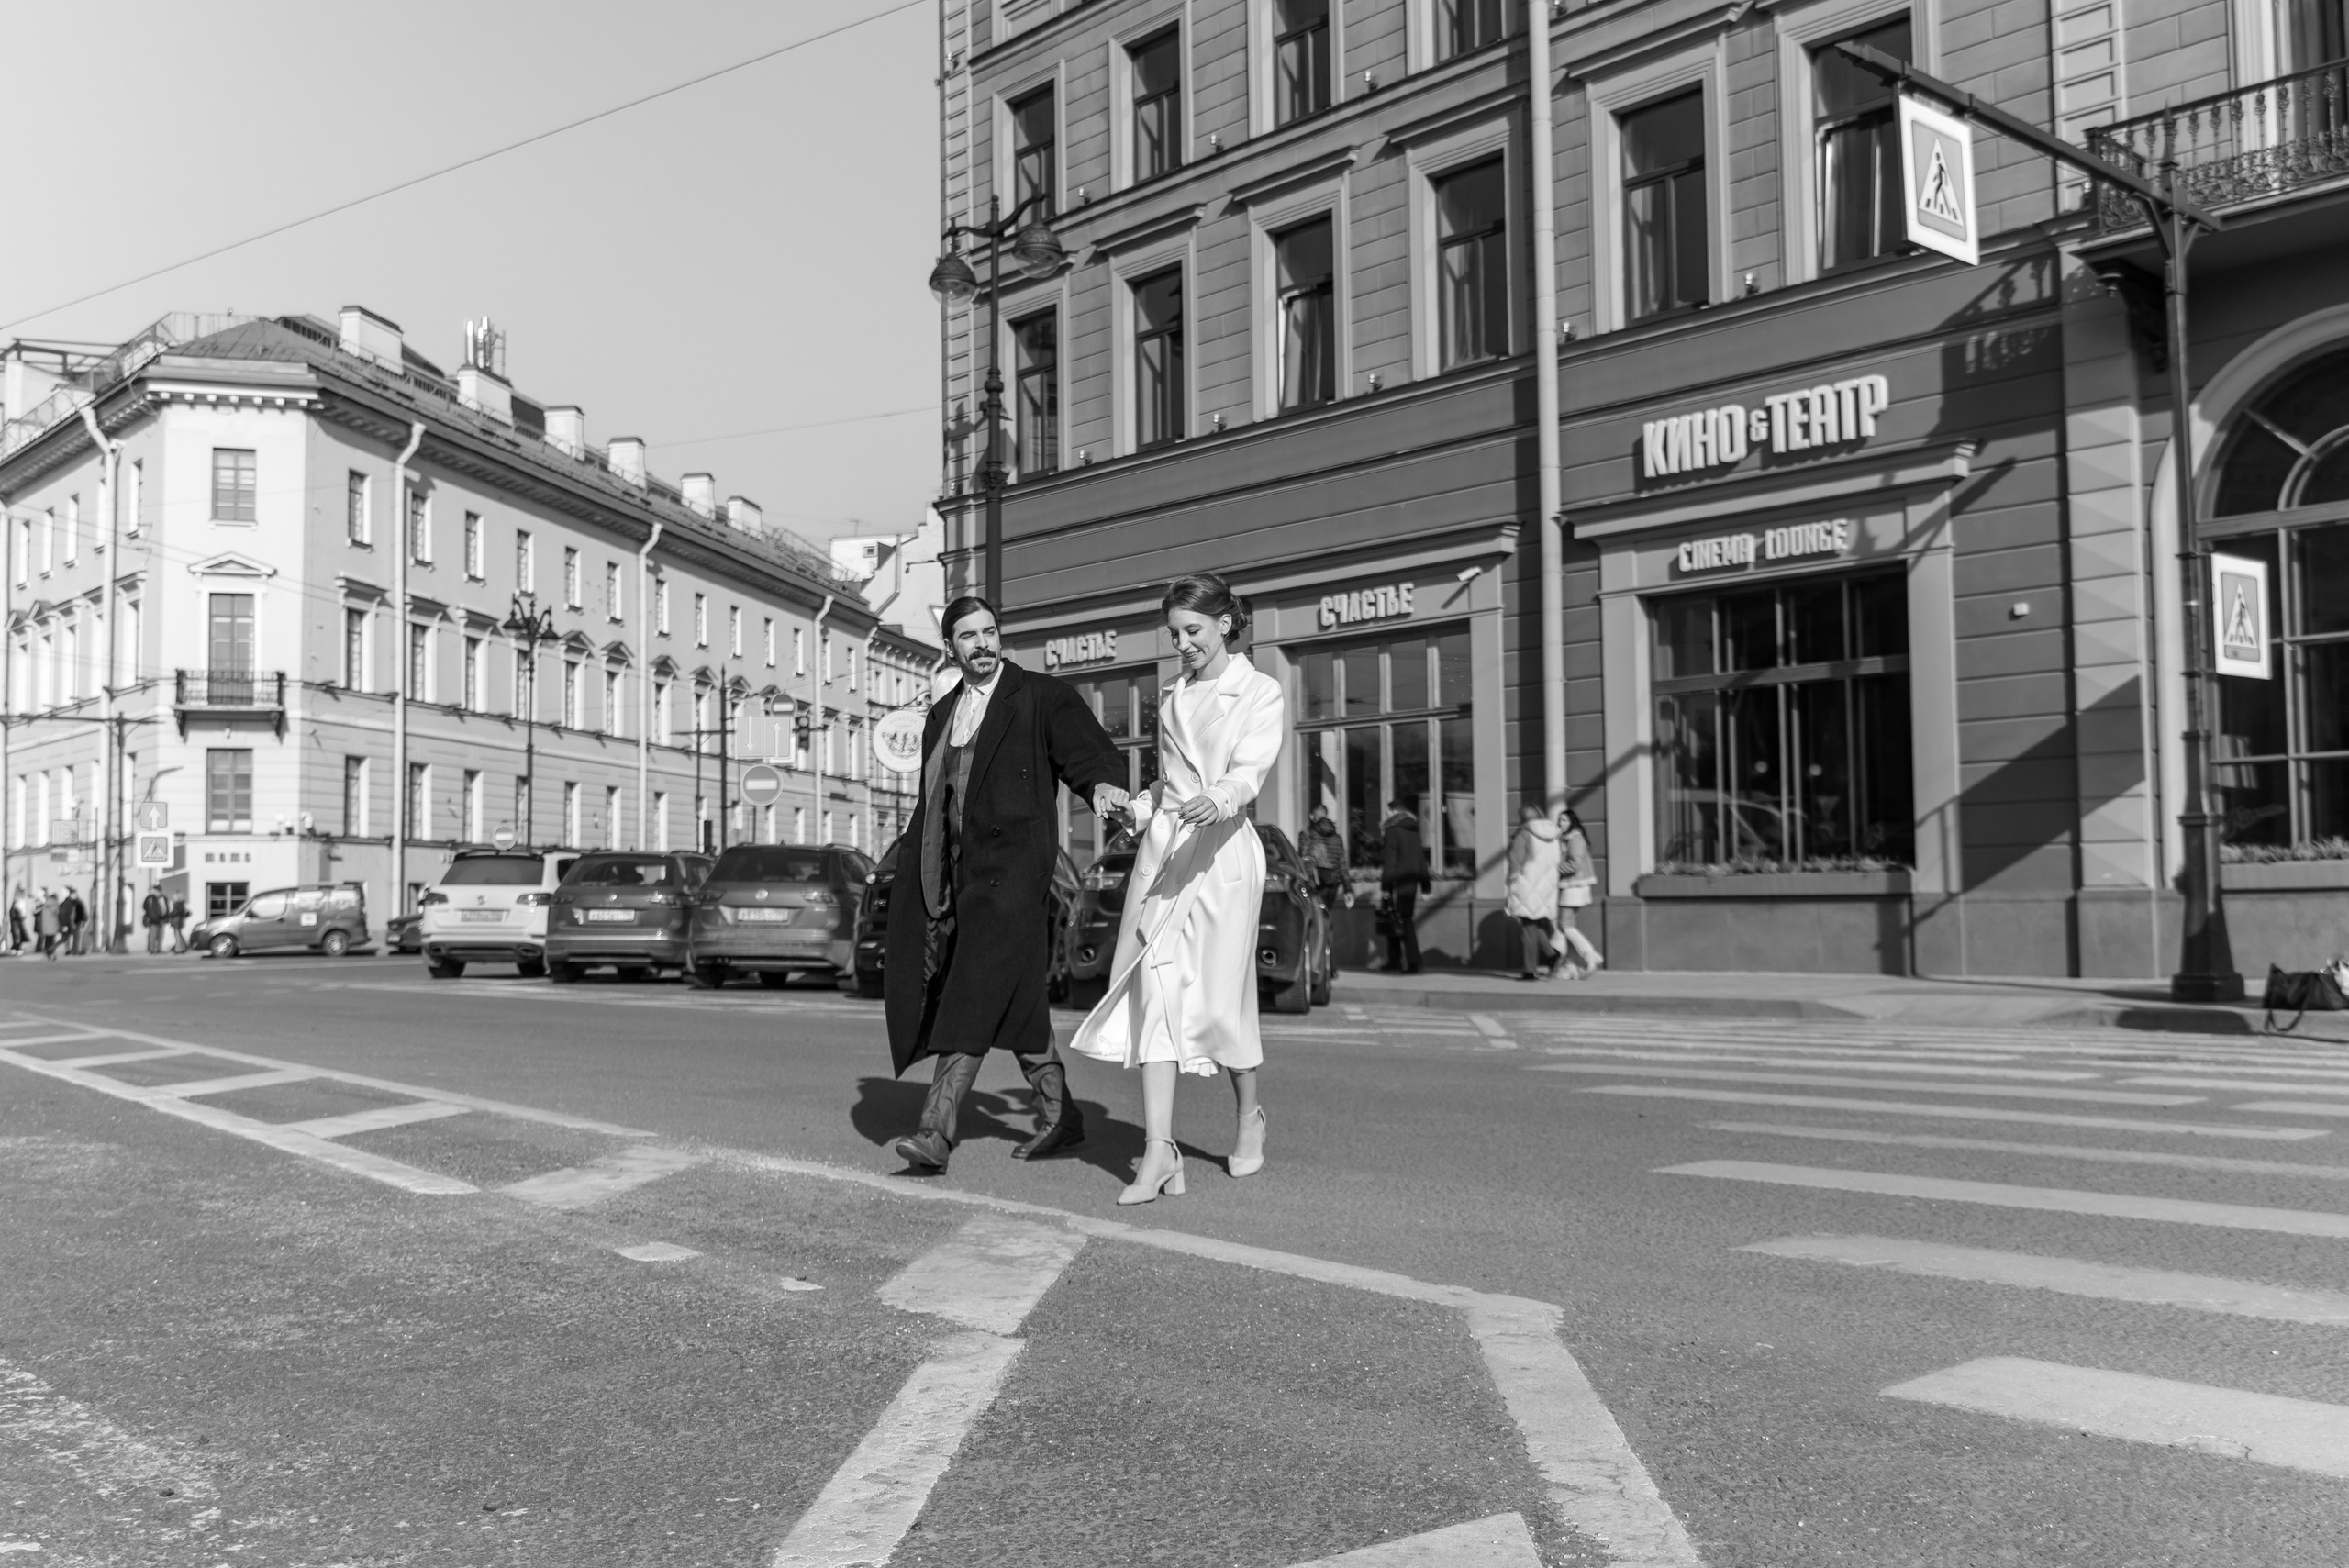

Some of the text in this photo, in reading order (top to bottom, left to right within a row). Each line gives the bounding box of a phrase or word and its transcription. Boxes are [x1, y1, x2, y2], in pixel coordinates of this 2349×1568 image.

[1677, 517, 1850, 572] CINEMA LOUNGE
[1319, 582, 1415, 627] СЧАСТЬЕ
[1045, 629, 1118, 666] СЧАСТЬЕ
